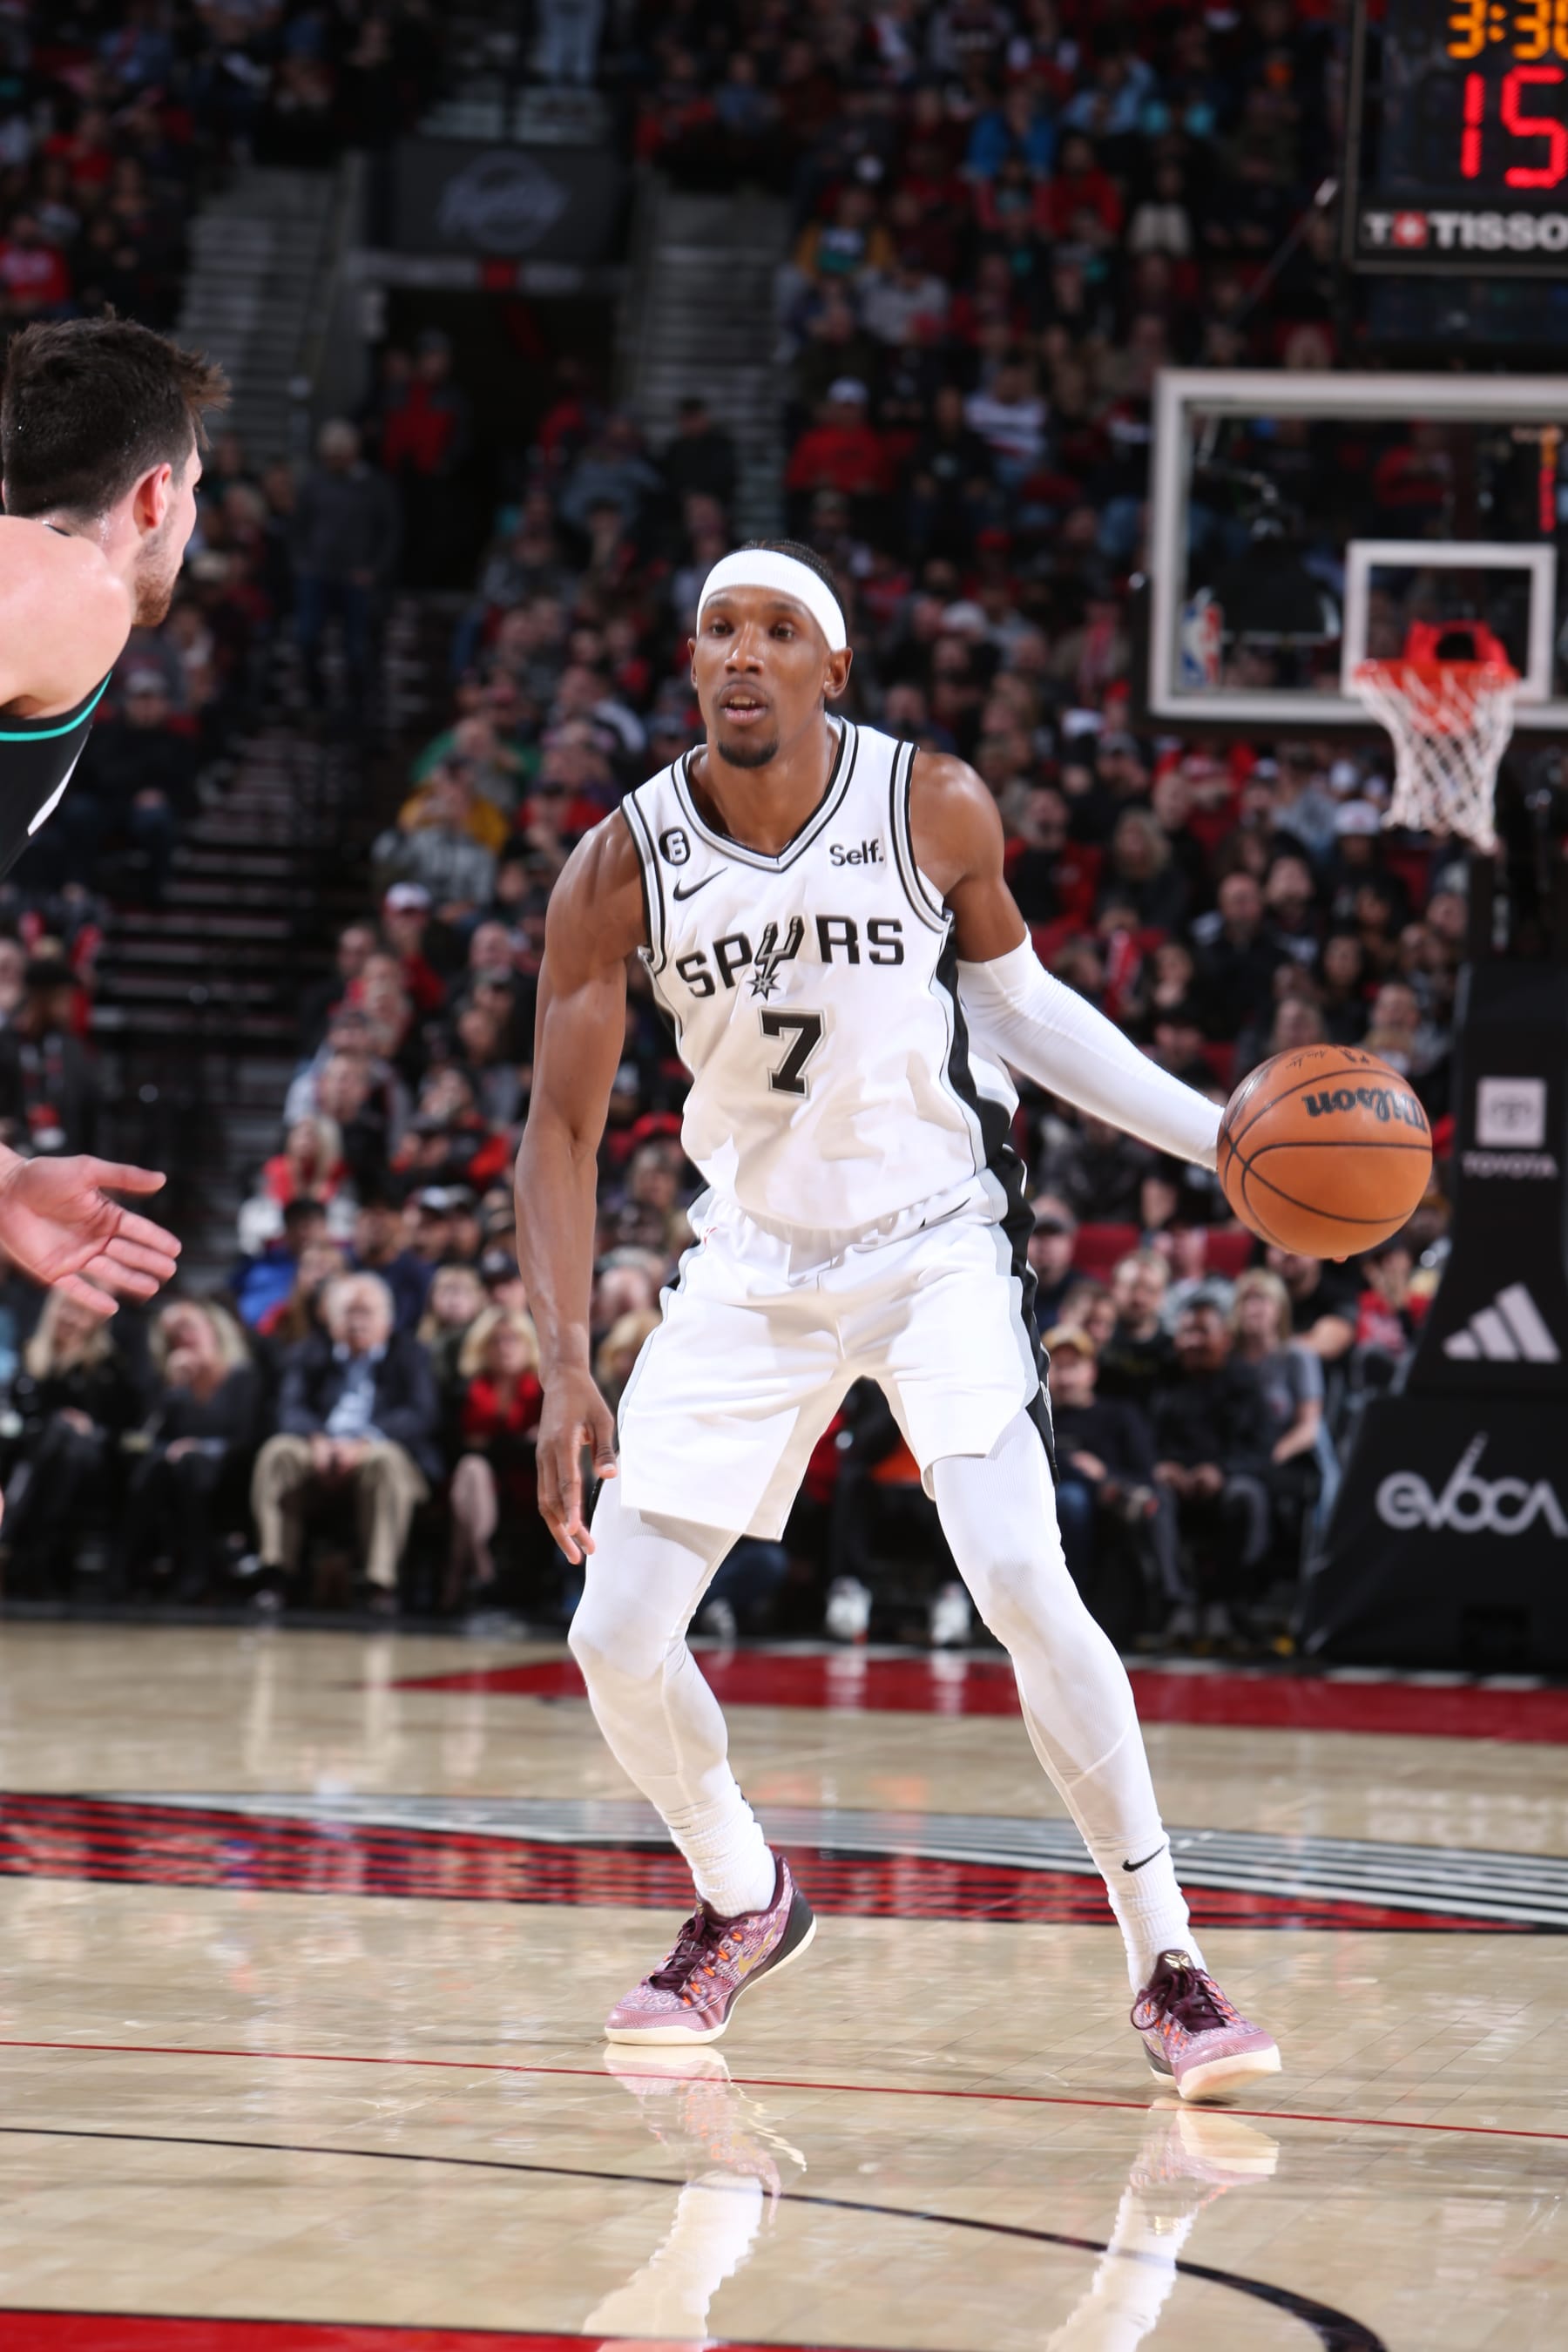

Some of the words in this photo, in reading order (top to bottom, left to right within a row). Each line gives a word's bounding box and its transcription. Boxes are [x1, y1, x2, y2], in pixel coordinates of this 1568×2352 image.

[1461, 65, 1568, 188] 15
[662, 828, 688, 863] 6
[675, 914, 904, 1001] SPURS
[758, 1006, 826, 1099] 7
[1302, 1087, 1429, 1135] Wilson
[1462, 1151, 1557, 1179] TOYOTA
